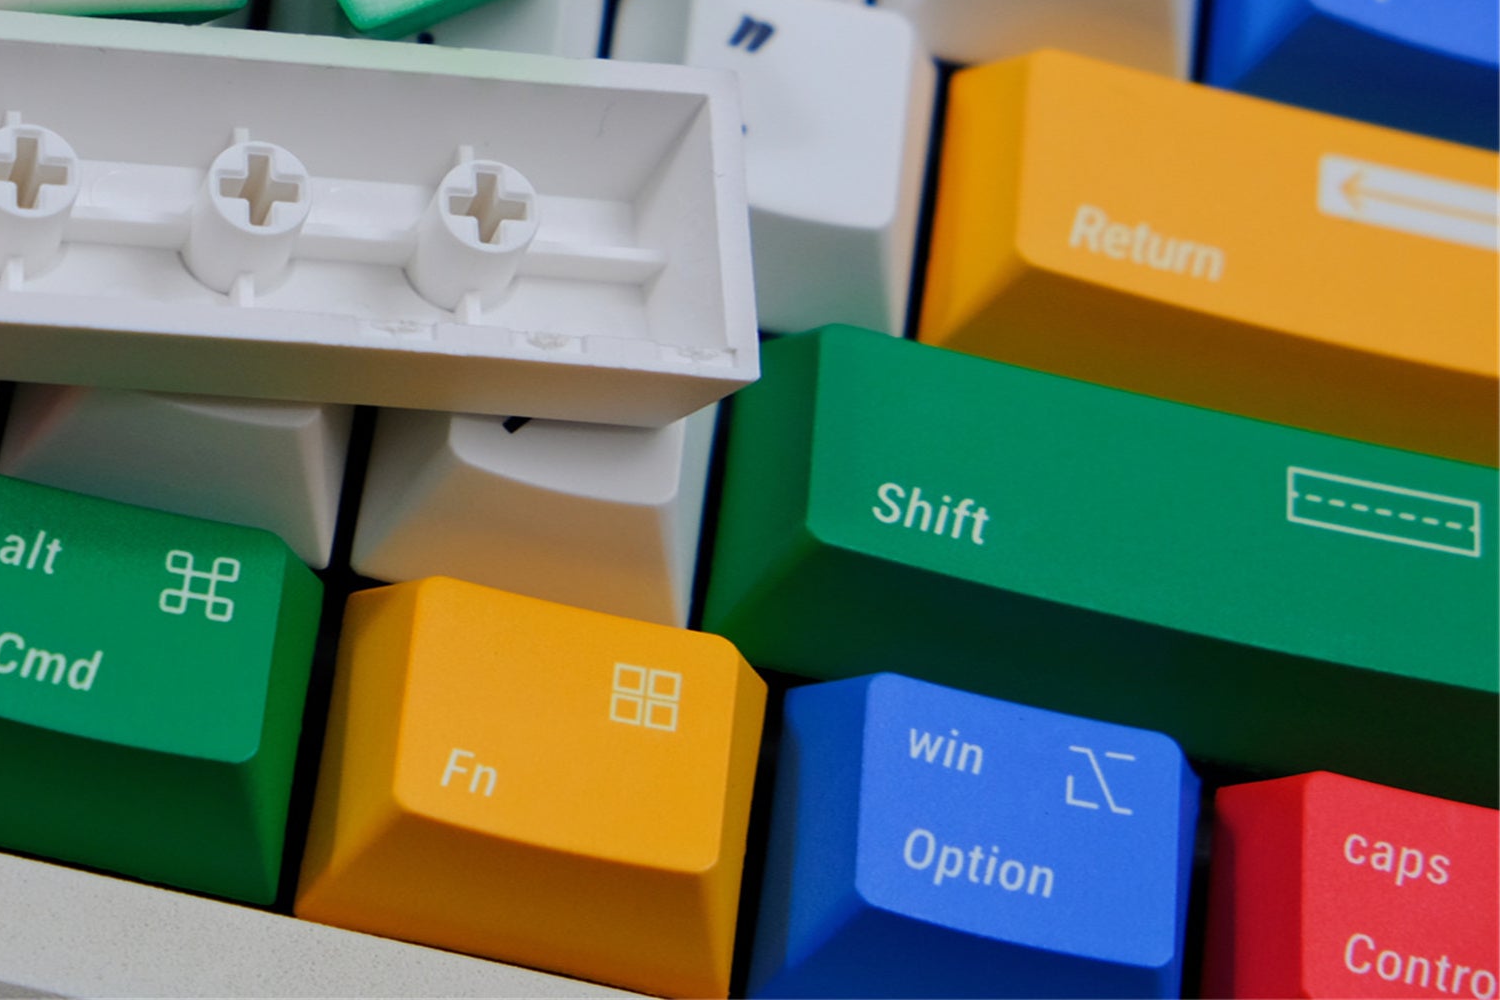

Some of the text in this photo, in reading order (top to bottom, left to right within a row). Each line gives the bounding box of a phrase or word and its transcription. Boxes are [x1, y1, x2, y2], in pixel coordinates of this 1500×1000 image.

[1068, 204, 1227, 282] Return
[872, 482, 990, 546] Shift
[440, 747, 498, 797] Fn
[909, 727, 984, 775] win
[903, 827, 1055, 899] Option
[1343, 833, 1451, 887] caps
[1343, 932, 1498, 1000] Contro
